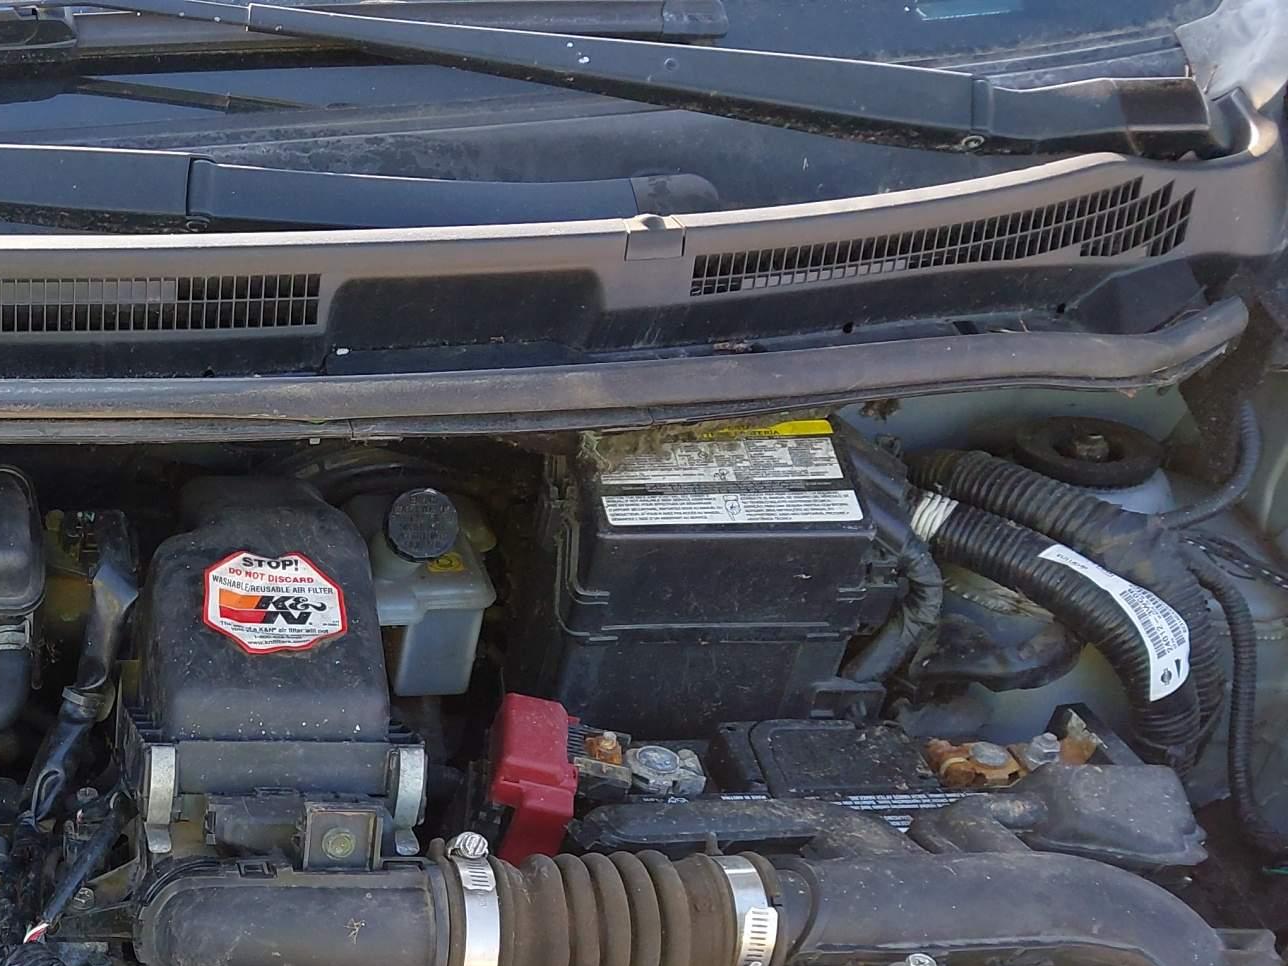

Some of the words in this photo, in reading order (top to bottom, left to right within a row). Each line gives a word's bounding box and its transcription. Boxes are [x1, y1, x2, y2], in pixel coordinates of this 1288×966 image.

[242, 557, 299, 571] STOP!
[229, 568, 242, 576] DO
[245, 571, 266, 580] NOT
[268, 575, 314, 583] DISCARD
[212, 575, 289, 593] WASHABLE/REUSABLE
